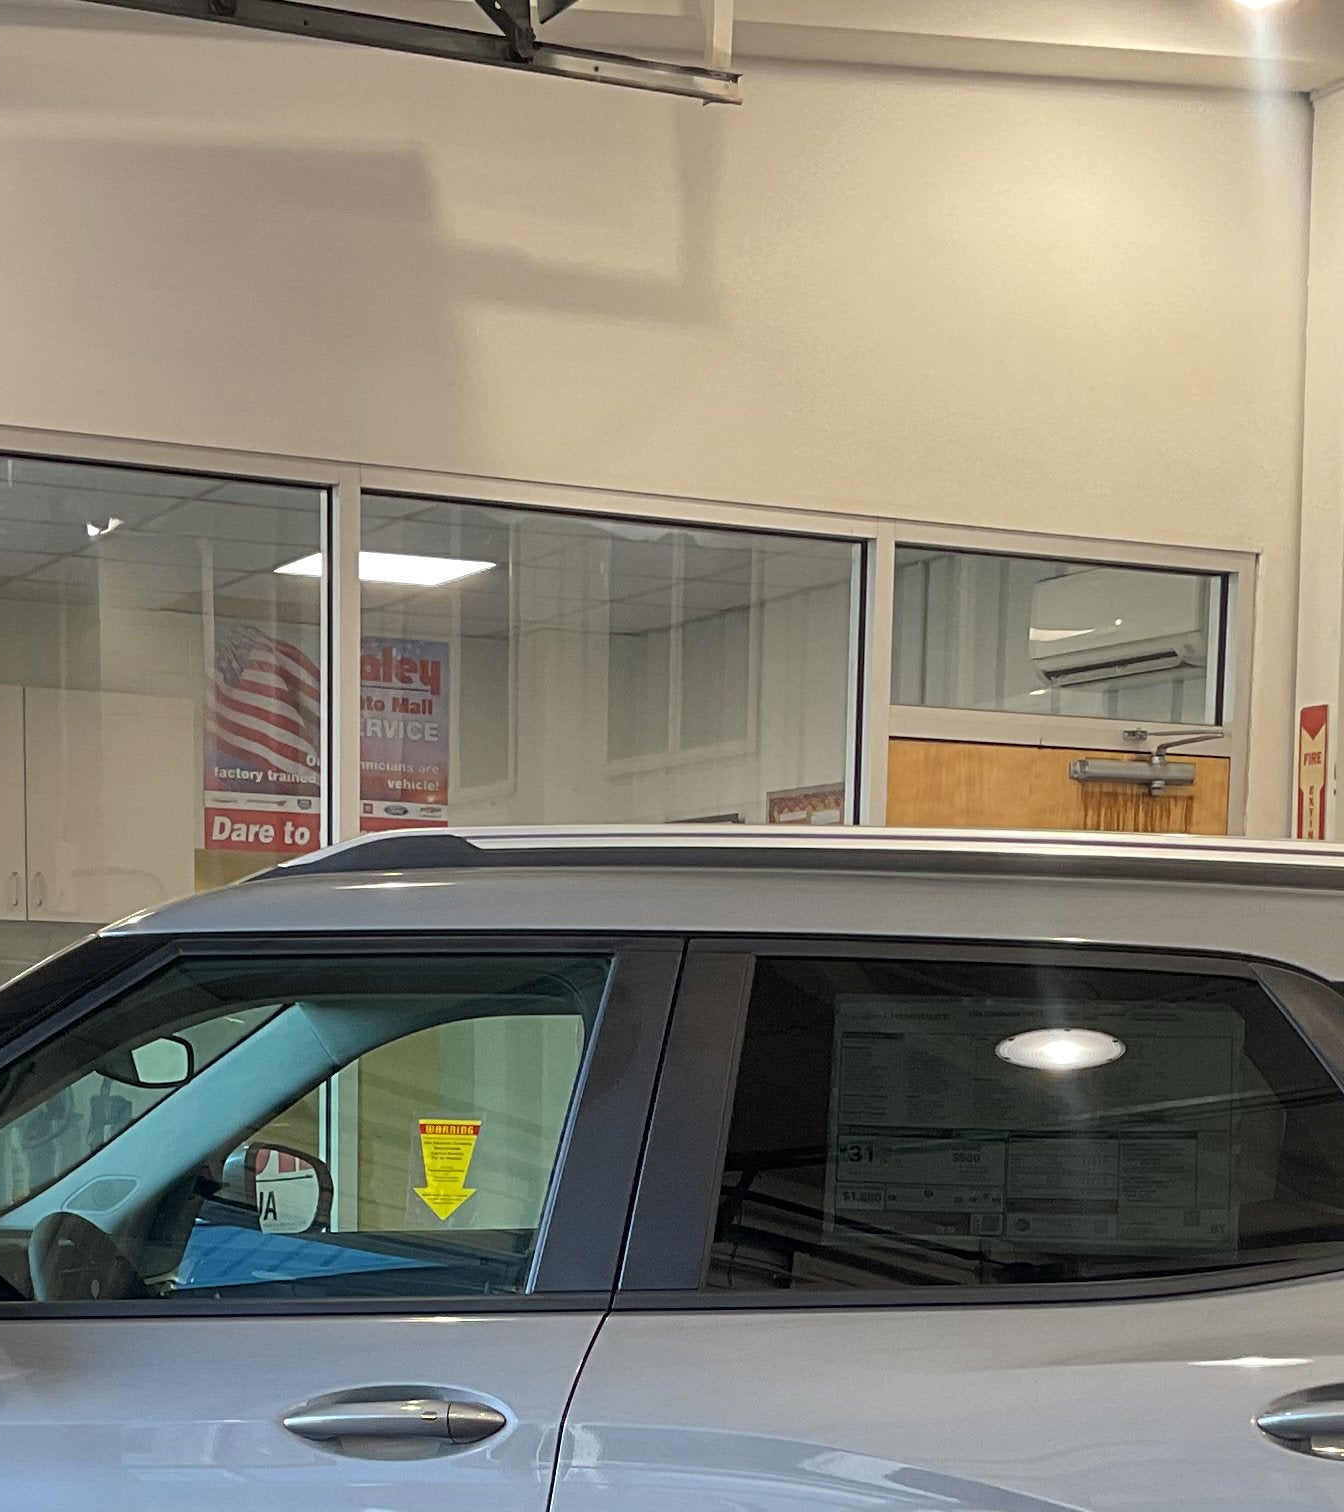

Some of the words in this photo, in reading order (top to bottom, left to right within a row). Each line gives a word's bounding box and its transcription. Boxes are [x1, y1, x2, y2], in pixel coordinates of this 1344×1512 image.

[392, 696, 432, 714] Mall
[1304, 752, 1322, 766] FIRE
[215, 767, 263, 783] factory
[267, 770, 317, 783] trained
[387, 778, 439, 792] vehicle!
[212, 815, 274, 843] Dare
[284, 821, 310, 845] to
